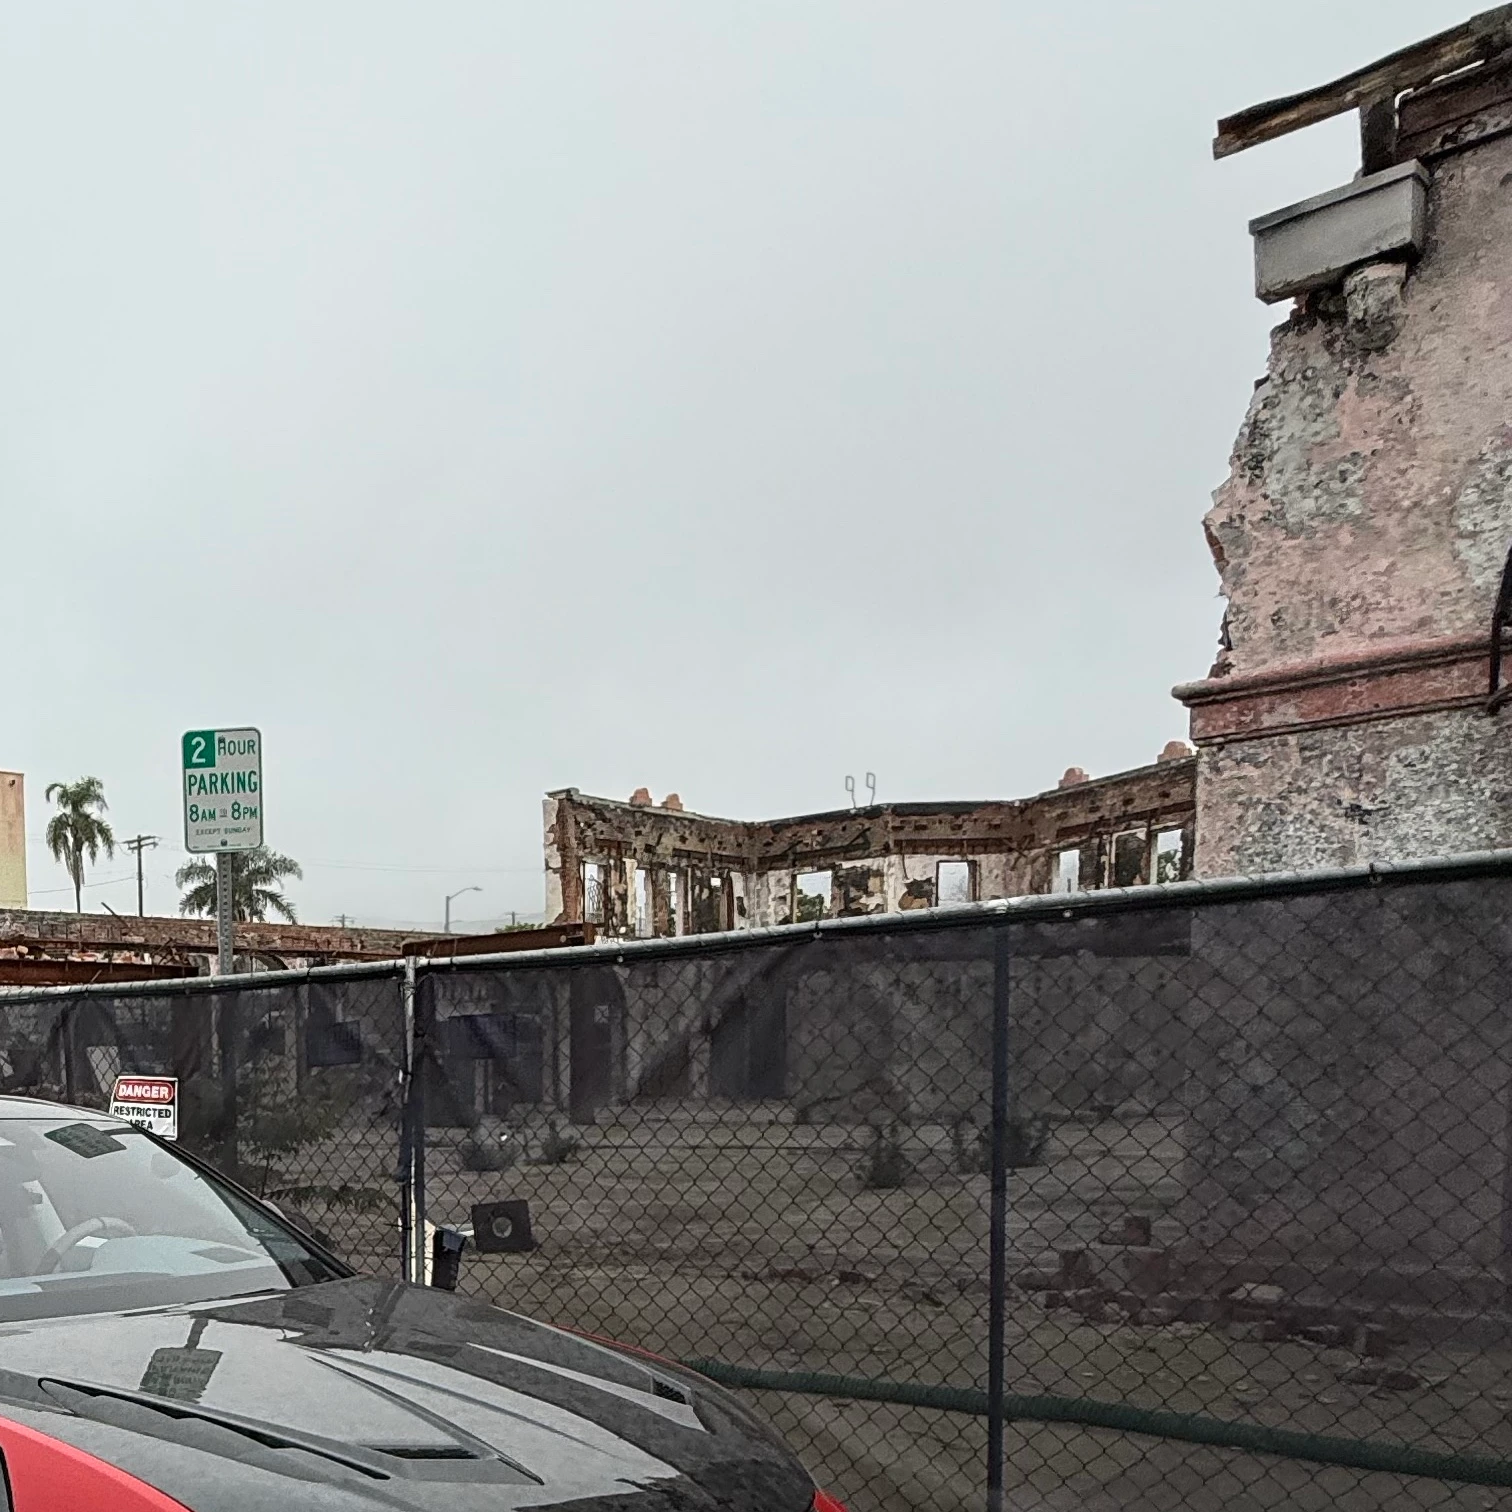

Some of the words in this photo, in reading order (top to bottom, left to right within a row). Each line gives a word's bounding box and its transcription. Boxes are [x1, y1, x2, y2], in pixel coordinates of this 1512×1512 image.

[191, 736, 206, 764] 2
[217, 738, 256, 756] HOUR
[188, 770, 258, 796] PARKING
[195, 828, 221, 836] EXCEPT
[118, 1084, 169, 1099] DANGER
[113, 1105, 172, 1119] RESTRICTED
